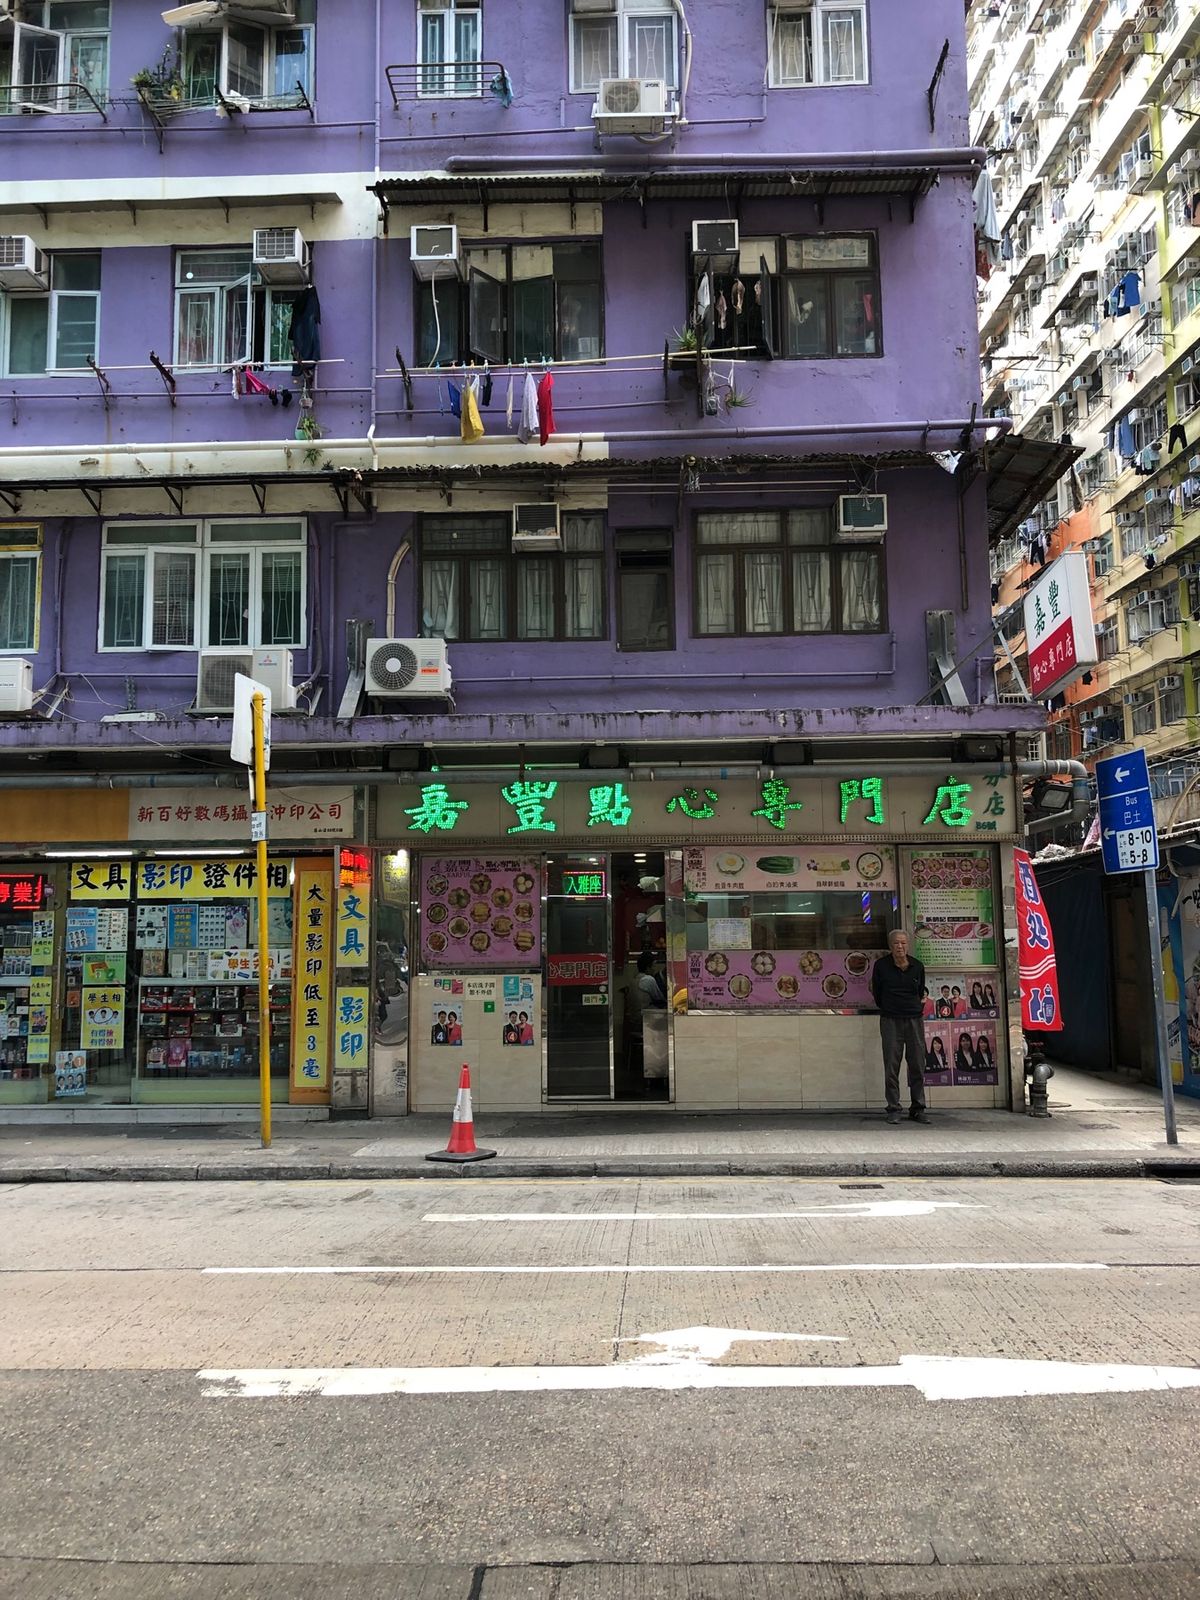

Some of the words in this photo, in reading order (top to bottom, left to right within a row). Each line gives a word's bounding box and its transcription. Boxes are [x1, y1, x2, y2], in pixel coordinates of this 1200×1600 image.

[1033, 633, 1073, 683] 點心專門店
[1125, 796, 1138, 806] Bus
[137, 803, 343, 823] 新百好數碼攝沖印公司
[1123, 810, 1141, 825] 巴士
[1127, 830, 1152, 846] 8-10
[1129, 848, 1148, 864] 5-8
[73, 864, 128, 891] 文具
[142, 863, 193, 891] 影印
[202, 862, 289, 890] 證件相
[338, 895, 367, 957] 文具
[301, 883, 326, 1080] 大量影印低至3毫
[88, 993, 121, 1003] 學生相
[338, 996, 366, 1059] 影印
[436, 1032, 445, 1041] 4
